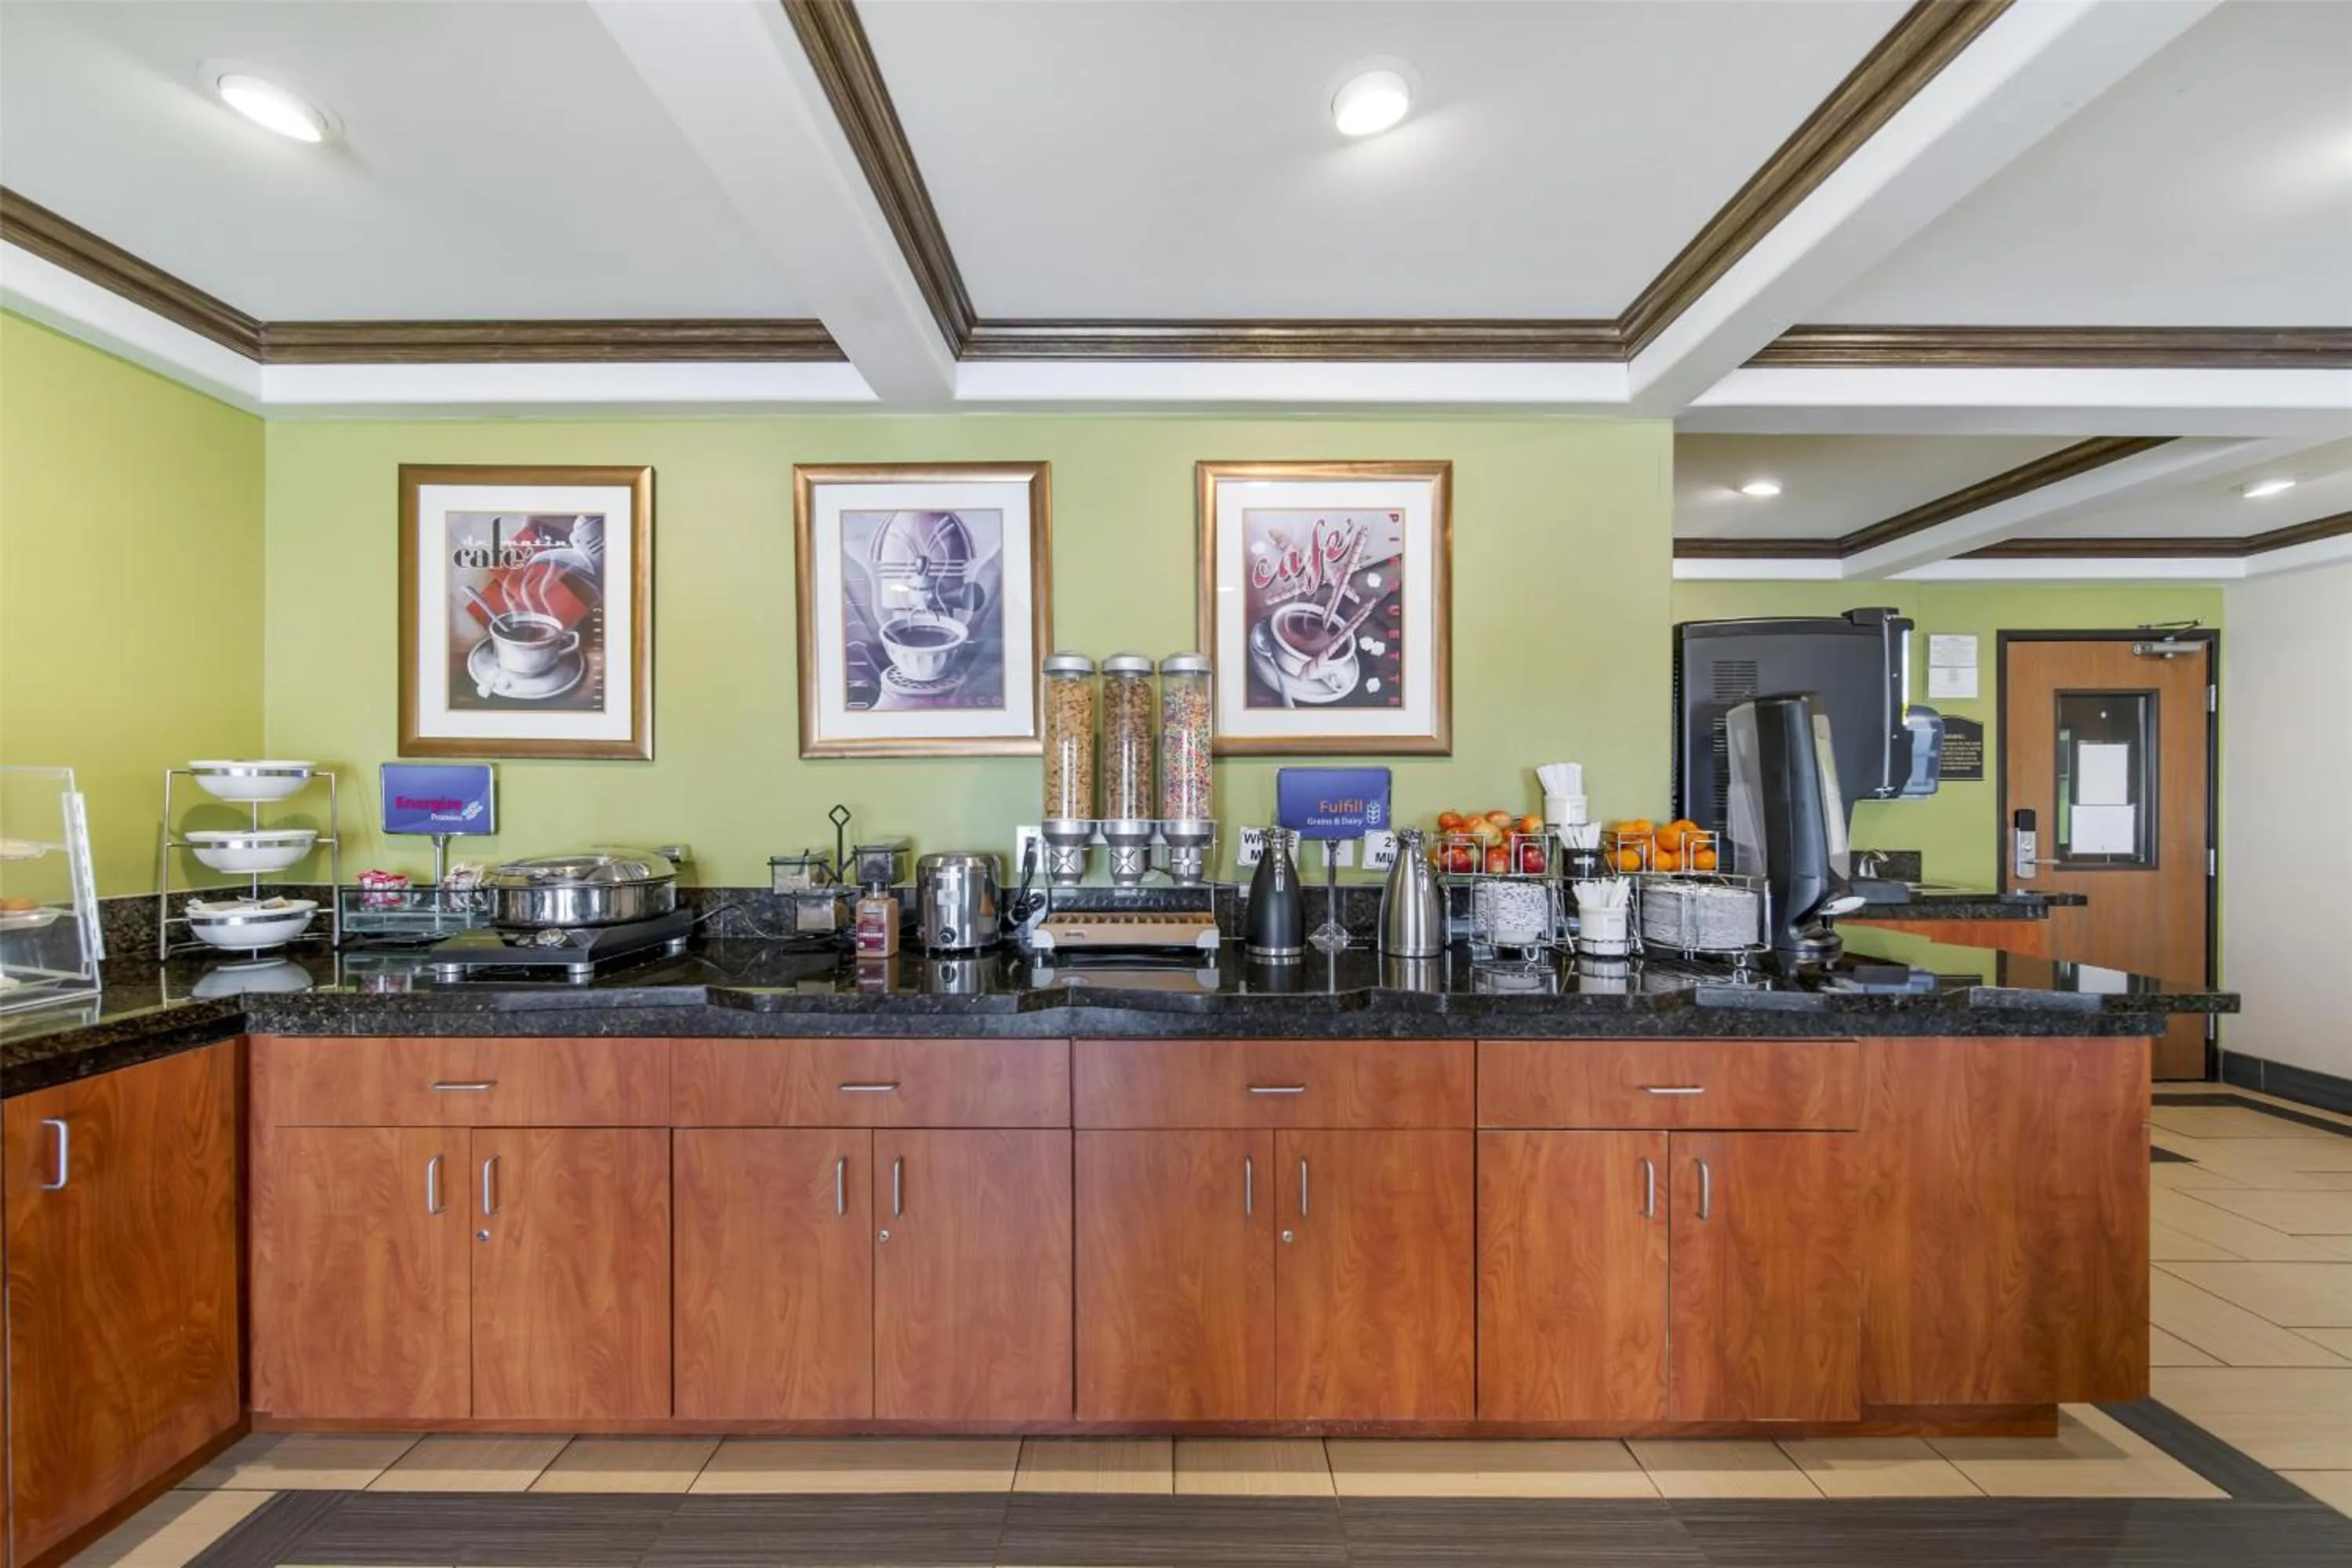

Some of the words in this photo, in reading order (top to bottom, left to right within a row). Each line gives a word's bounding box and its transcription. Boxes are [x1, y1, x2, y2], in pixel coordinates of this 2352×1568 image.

[395, 796, 462, 813] Energize
[1319, 799, 1363, 813] Fulfill
[1307, 817, 1333, 826] Grains
[1341, 817, 1363, 827] Dairy
